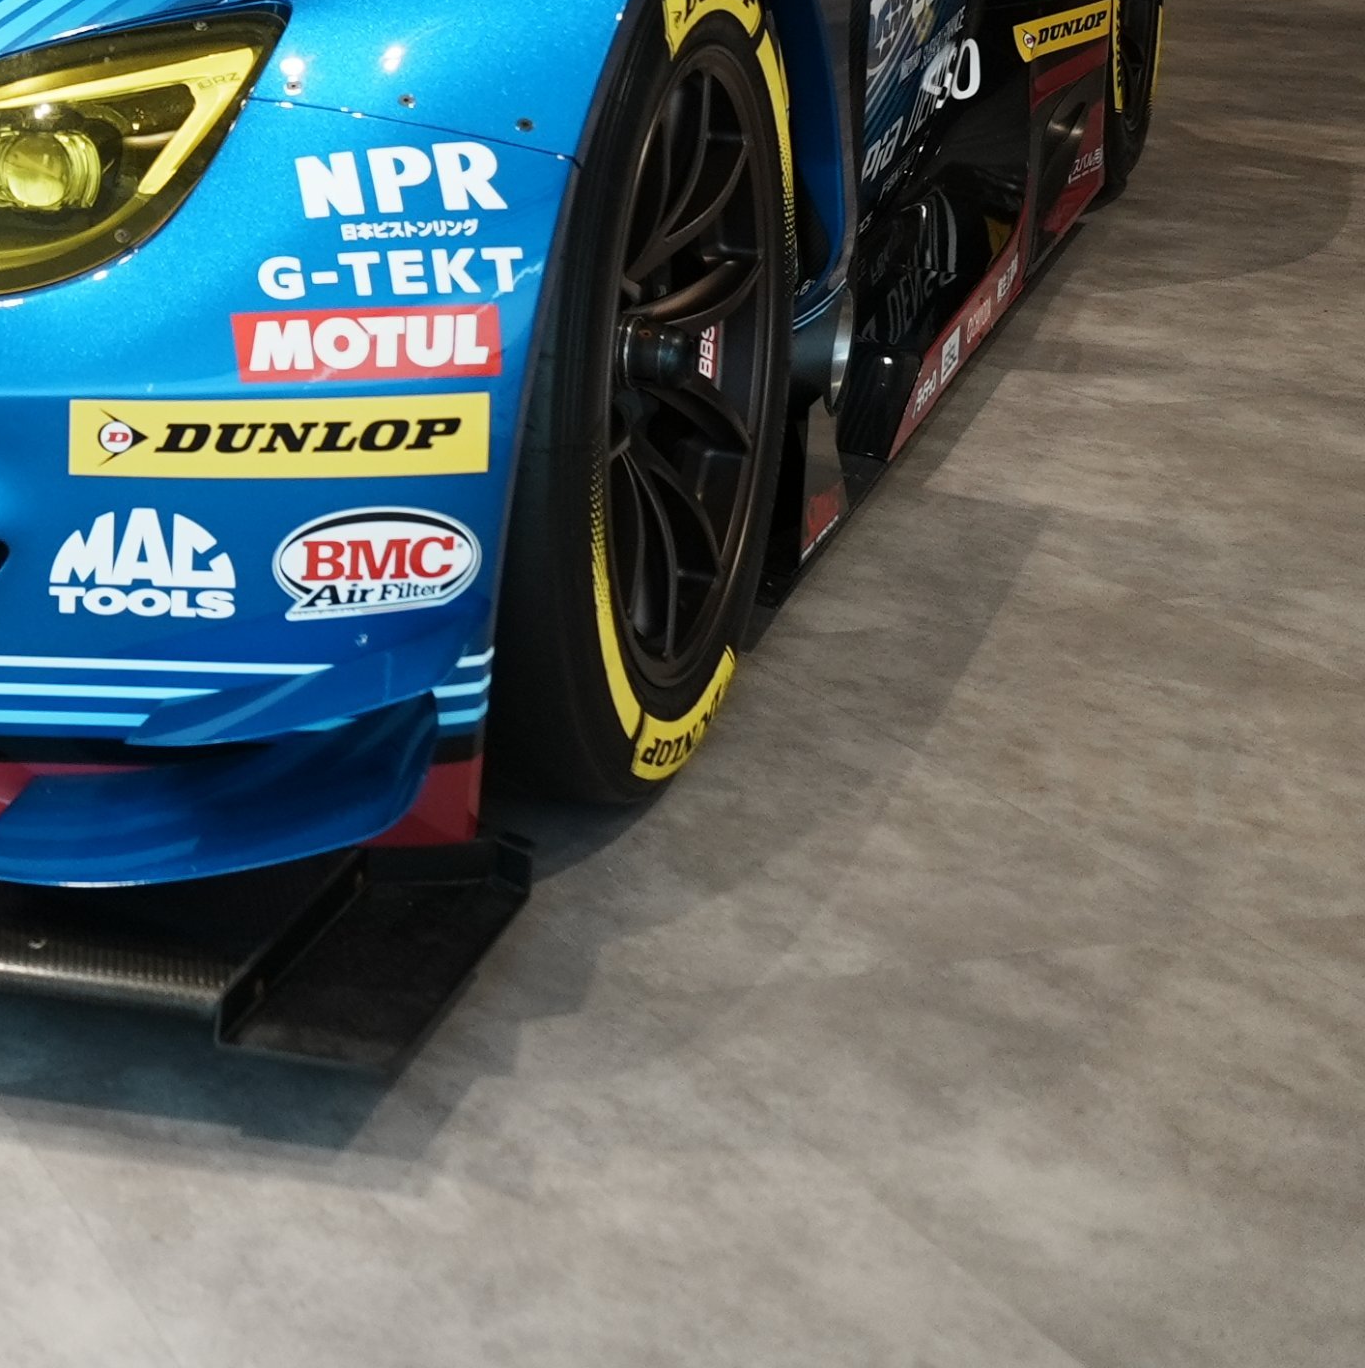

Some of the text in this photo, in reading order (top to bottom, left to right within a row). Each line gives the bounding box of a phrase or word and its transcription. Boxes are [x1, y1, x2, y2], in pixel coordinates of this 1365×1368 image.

[1038, 10, 1107, 45] DUNLOP
[294, 141, 508, 220] NPR
[340, 218, 480, 240] 日本ピストンリング
[257, 245, 524, 301] G-TEKT
[249, 315, 491, 373] MOTUL
[698, 325, 715, 379] BBS
[154, 416, 462, 454] DUNLOP
[49, 507, 237, 590] MAC
[300, 537, 459, 582] BMC
[49, 585, 236, 620] TOOLS
[300, 578, 441, 610] Air Filter
